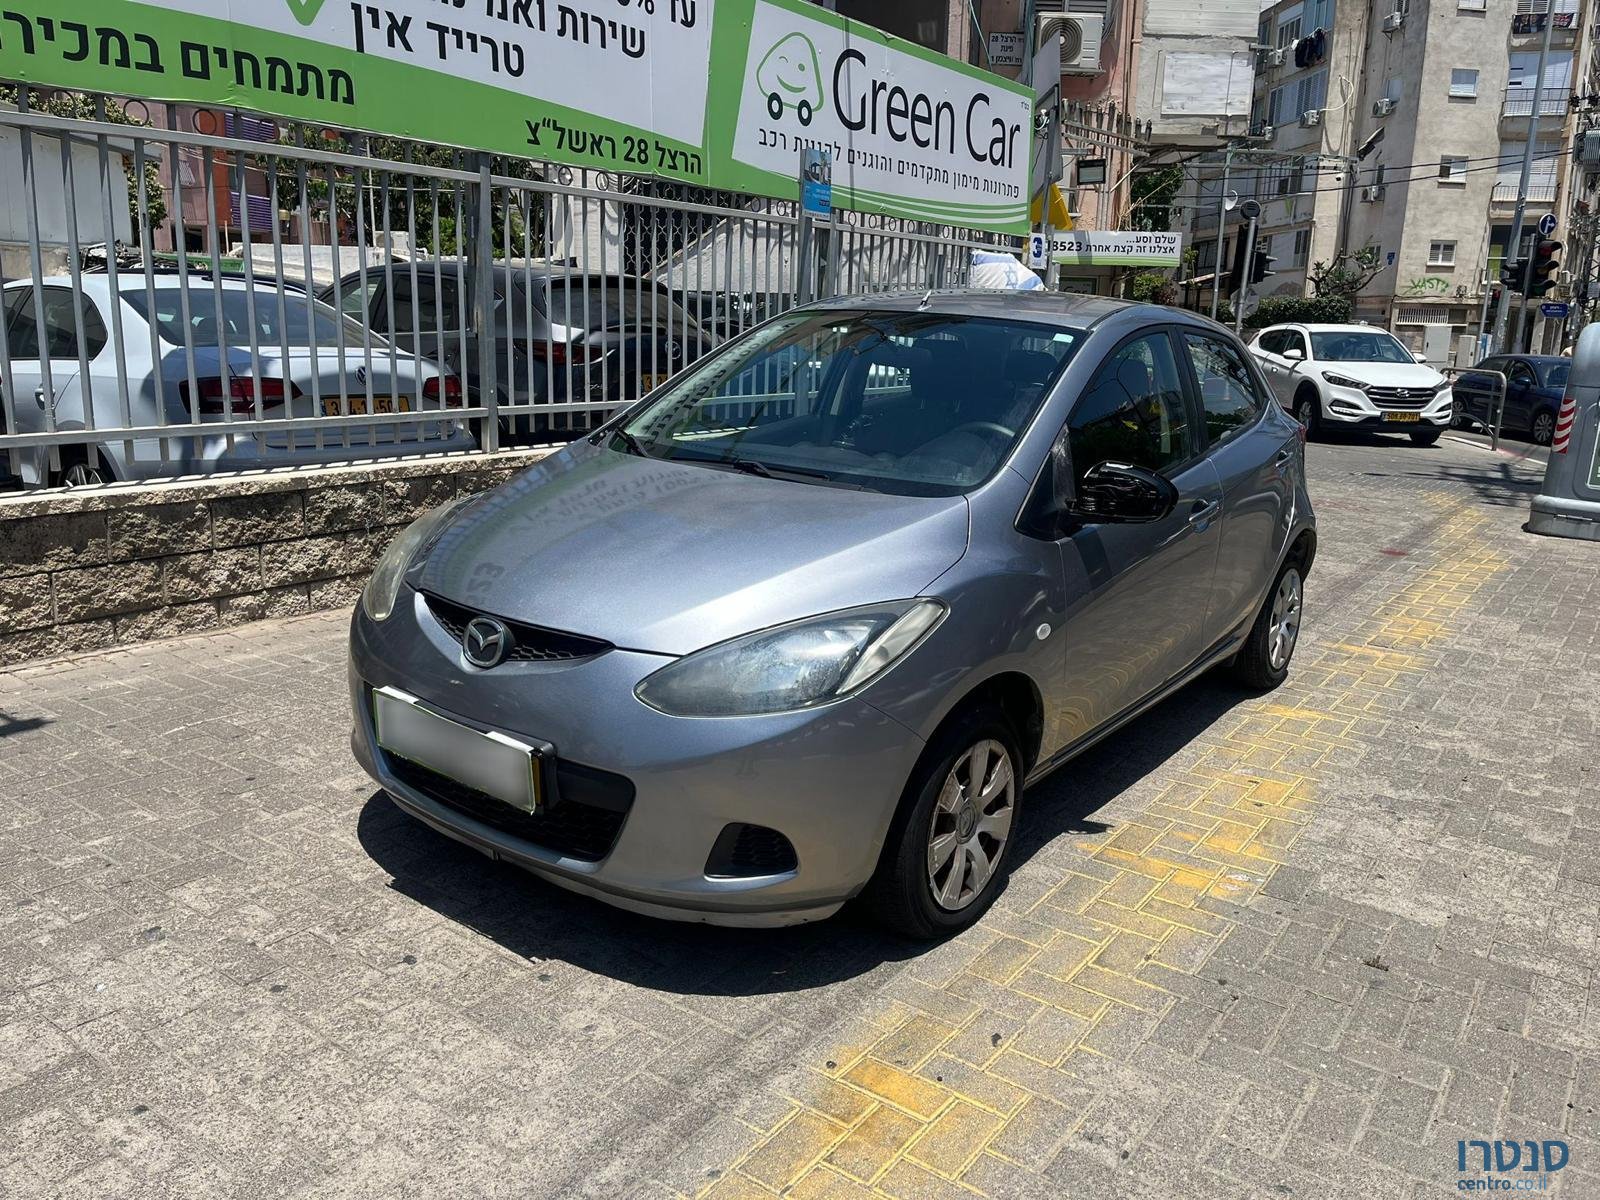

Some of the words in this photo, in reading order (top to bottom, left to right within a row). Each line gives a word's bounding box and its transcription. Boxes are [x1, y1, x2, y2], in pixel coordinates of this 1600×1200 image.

[351, 3, 413, 53] אין
[557, 5, 645, 59] שירות
[0, 10, 165, 73] במכיר
[426, 21, 525, 77] טרייד
[180, 40, 355, 105] מתמחים
[833, 48, 955, 155] Green
[965, 93, 1021, 169] Car
[623, 136, 649, 165] 28
[758, 128, 787, 150] רכב
[654, 140, 702, 175] הרצל
[847, 148, 893, 173] והוגנים
[898, 159, 949, 185] מתקדמים
[953, 171, 980, 190] מימון
[982, 178, 1020, 199] פתרונות
[1085, 244, 1111, 253] אחרת
[1113, 245, 1133, 255] קצת
[1136, 245, 1146, 253] זה
[1149, 244, 1175, 254] אצלנו
[1154, 234, 1176, 244] שלם
